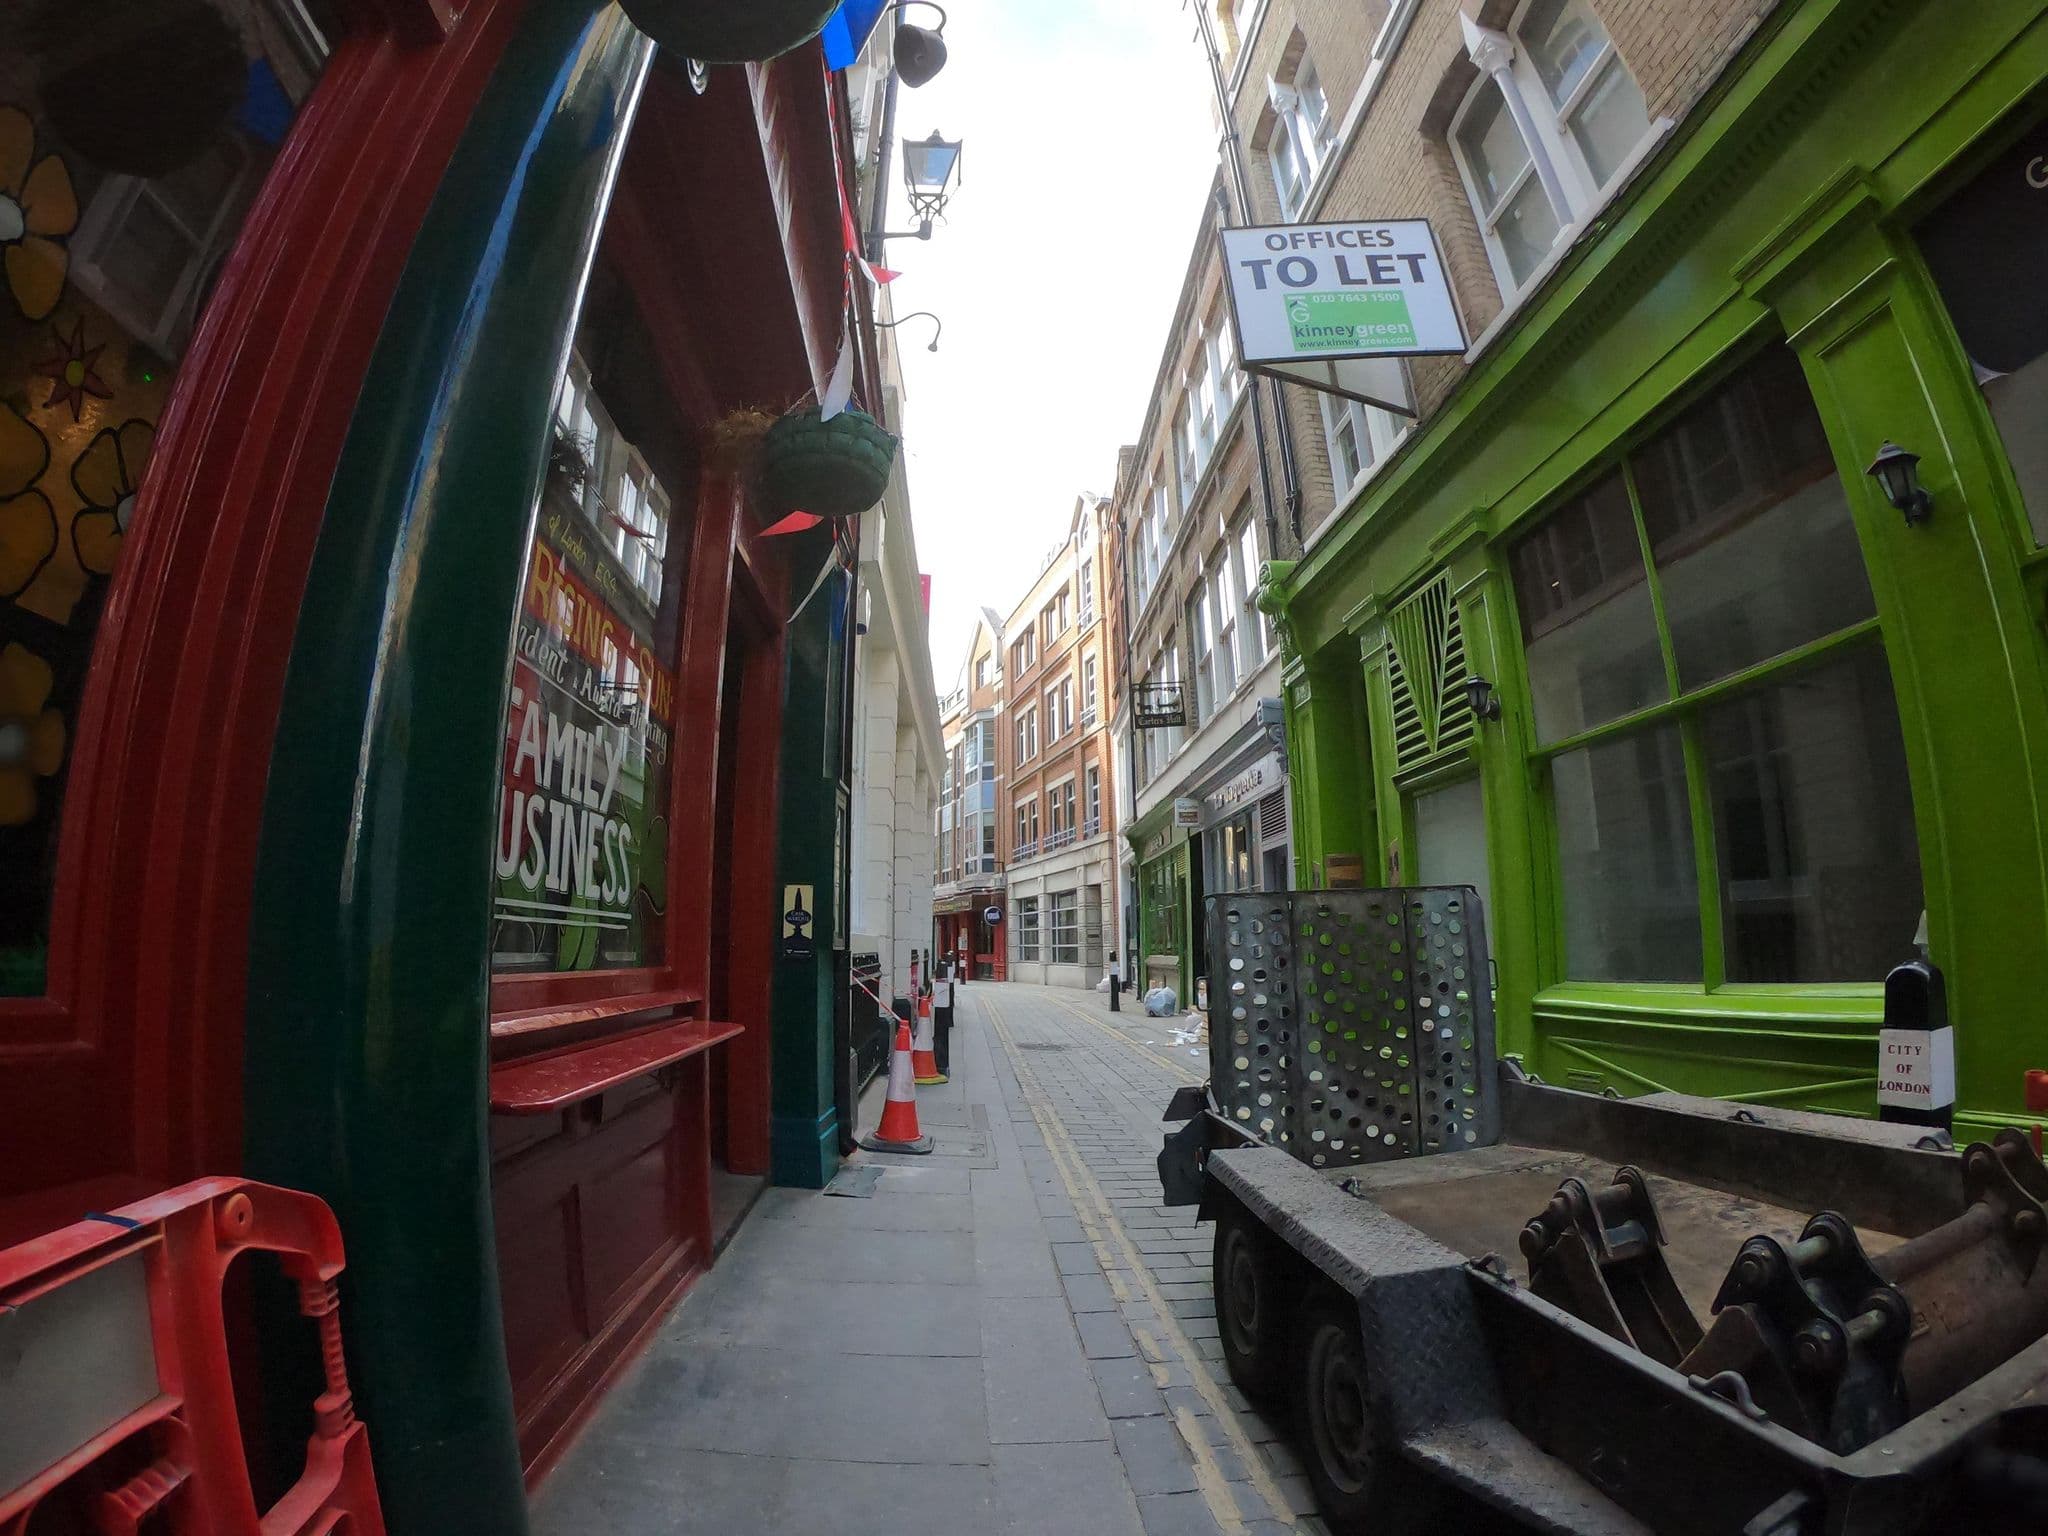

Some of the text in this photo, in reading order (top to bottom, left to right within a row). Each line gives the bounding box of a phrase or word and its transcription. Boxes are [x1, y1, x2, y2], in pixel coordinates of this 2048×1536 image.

[1264, 229, 1395, 251] OFFICES
[1241, 253, 1427, 290] TO LET
[1313, 295, 1335, 303] 020
[1294, 322, 1409, 338] kinneygreen
[1298, 336, 1413, 348] www.kinneygreen.com
[528, 542, 615, 671] RISING
[1888, 1044, 1922, 1055] CITY
[1896, 1064, 1913, 1074] OF
[1879, 1080, 1931, 1095] LONDON
